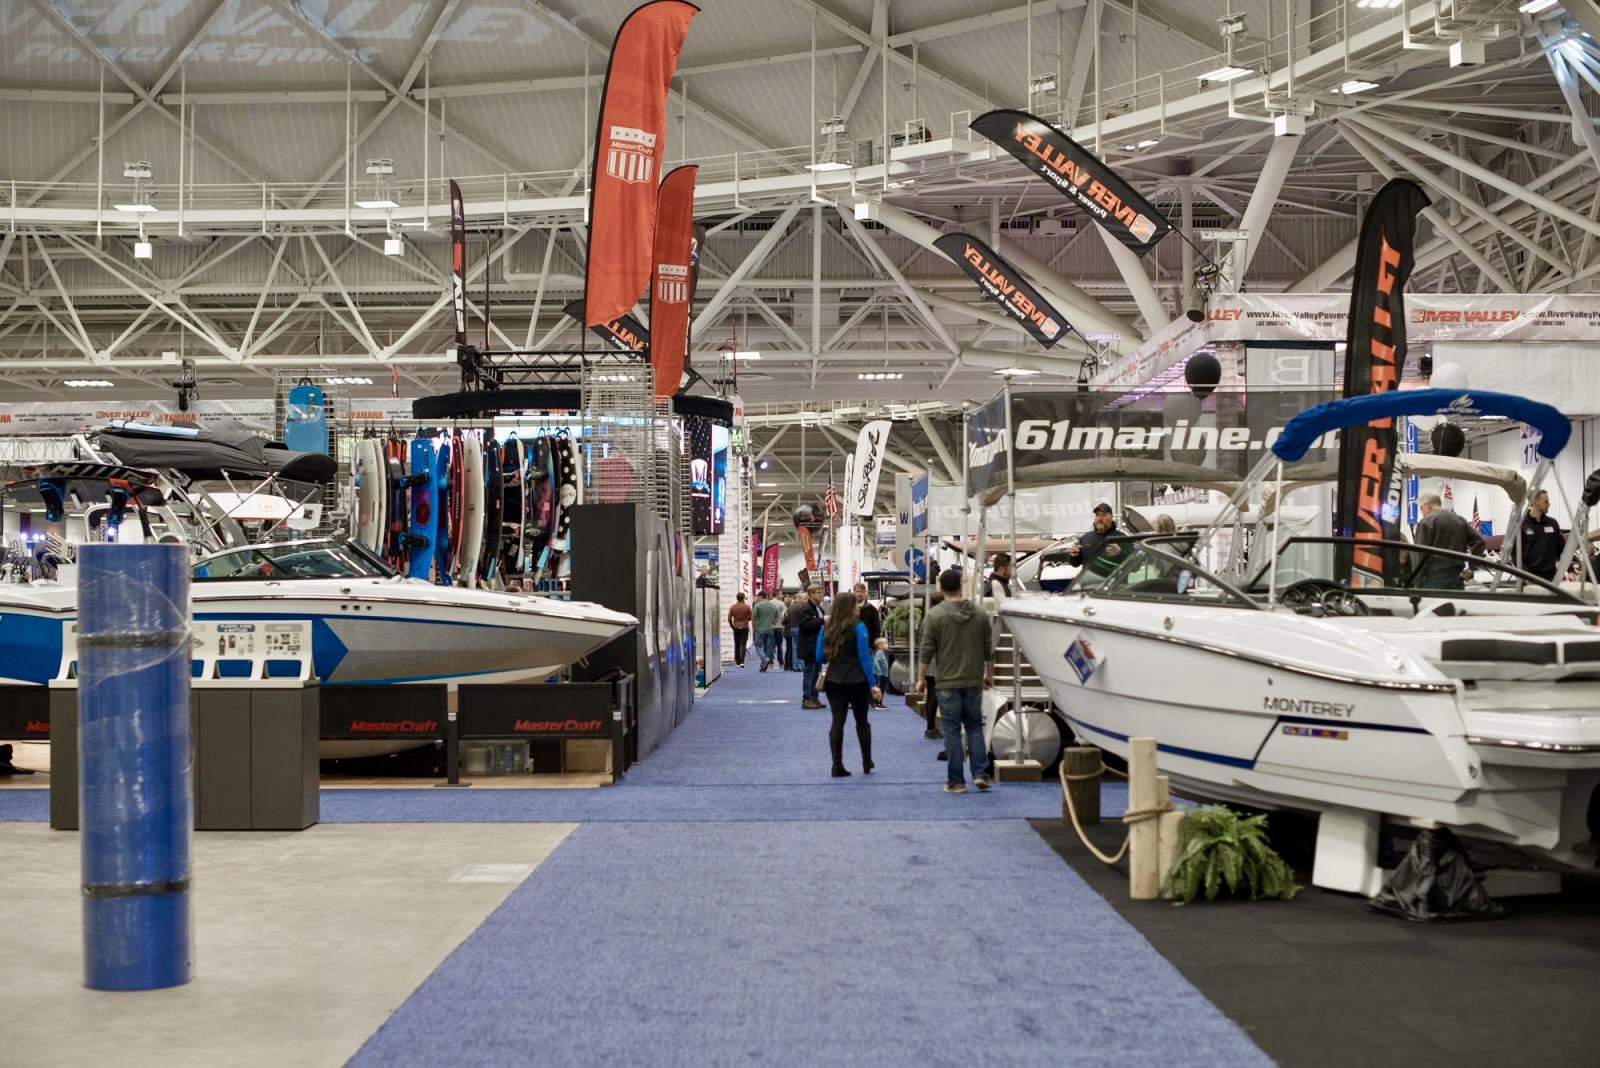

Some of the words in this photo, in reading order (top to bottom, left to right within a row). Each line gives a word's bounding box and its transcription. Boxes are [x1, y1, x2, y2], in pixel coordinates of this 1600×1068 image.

[1464, 310, 1521, 322] VALLEY
[352, 411, 383, 419] YAMAHA
[1015, 419, 1341, 450] 61marine.c
[1264, 697, 1355, 717] MONTEREY
[350, 720, 437, 732] MasterCraft
[514, 719, 603, 732] MasterCraft
